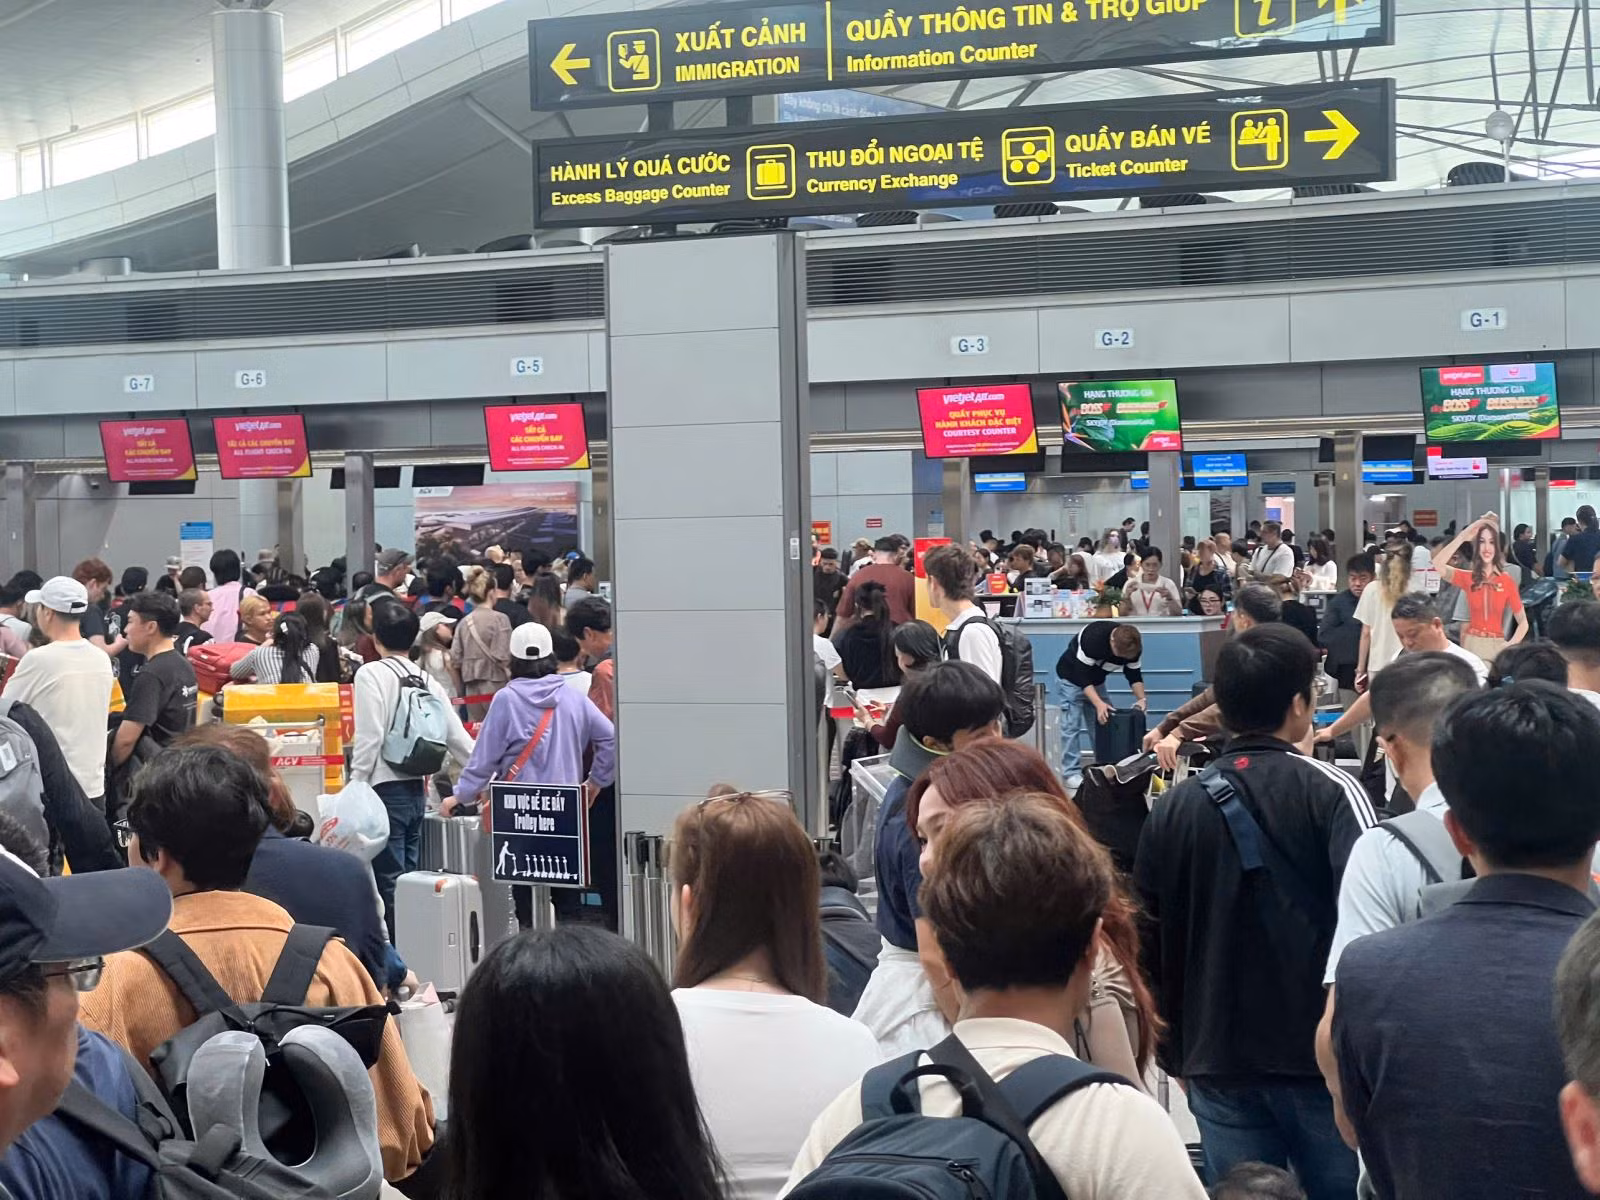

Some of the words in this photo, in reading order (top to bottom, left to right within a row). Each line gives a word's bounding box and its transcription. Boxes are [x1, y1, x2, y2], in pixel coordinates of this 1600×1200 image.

[846, 9, 912, 42] QUẦY
[919, 6, 1006, 35] THÔNG
[1012, 3, 1054, 26] TIN
[1061, 2, 1078, 22] &
[675, 21, 736, 52] XUẤT
[741, 18, 806, 47] CẢNH
[847, 50, 955, 72] Information
[960, 42, 1038, 64] Counter
[676, 56, 800, 82] IMMIGRATION
[1065, 125, 1124, 152] QUẦY
[1130, 124, 1176, 148] BÁN
[1182, 120, 1211, 144] VÉ
[806, 148, 846, 168] THU
[851, 138, 884, 166] ĐỔI
[890, 142, 953, 164] NGOẠI
[957, 136, 984, 162] TỆ
[550, 161, 600, 182] HÀNH
[606, 157, 629, 178] LÝ
[634, 154, 674, 177] QUÁ
[678, 152, 731, 174] CƯỚC
[1066, 162, 1117, 178] Ticket
[1120, 158, 1188, 175] Counter
[806, 178, 876, 193] Currency
[880, 173, 958, 190] Exchange
[552, 192, 602, 206] Excess
[605, 188, 668, 205] Baggage
[672, 184, 730, 198] Counter
[1470, 312, 1500, 328] G-1
[958, 338, 985, 352] G-3
[1102, 331, 1130, 346] G-2
[516, 360, 540, 373] G-5
[129, 378, 150, 390] G-7
[241, 372, 263, 386] G-6
[276, 757, 300, 766] ACV
[542, 796, 550, 811] XE
[514, 812, 538, 833] Trolley
[538, 814, 555, 832] here
